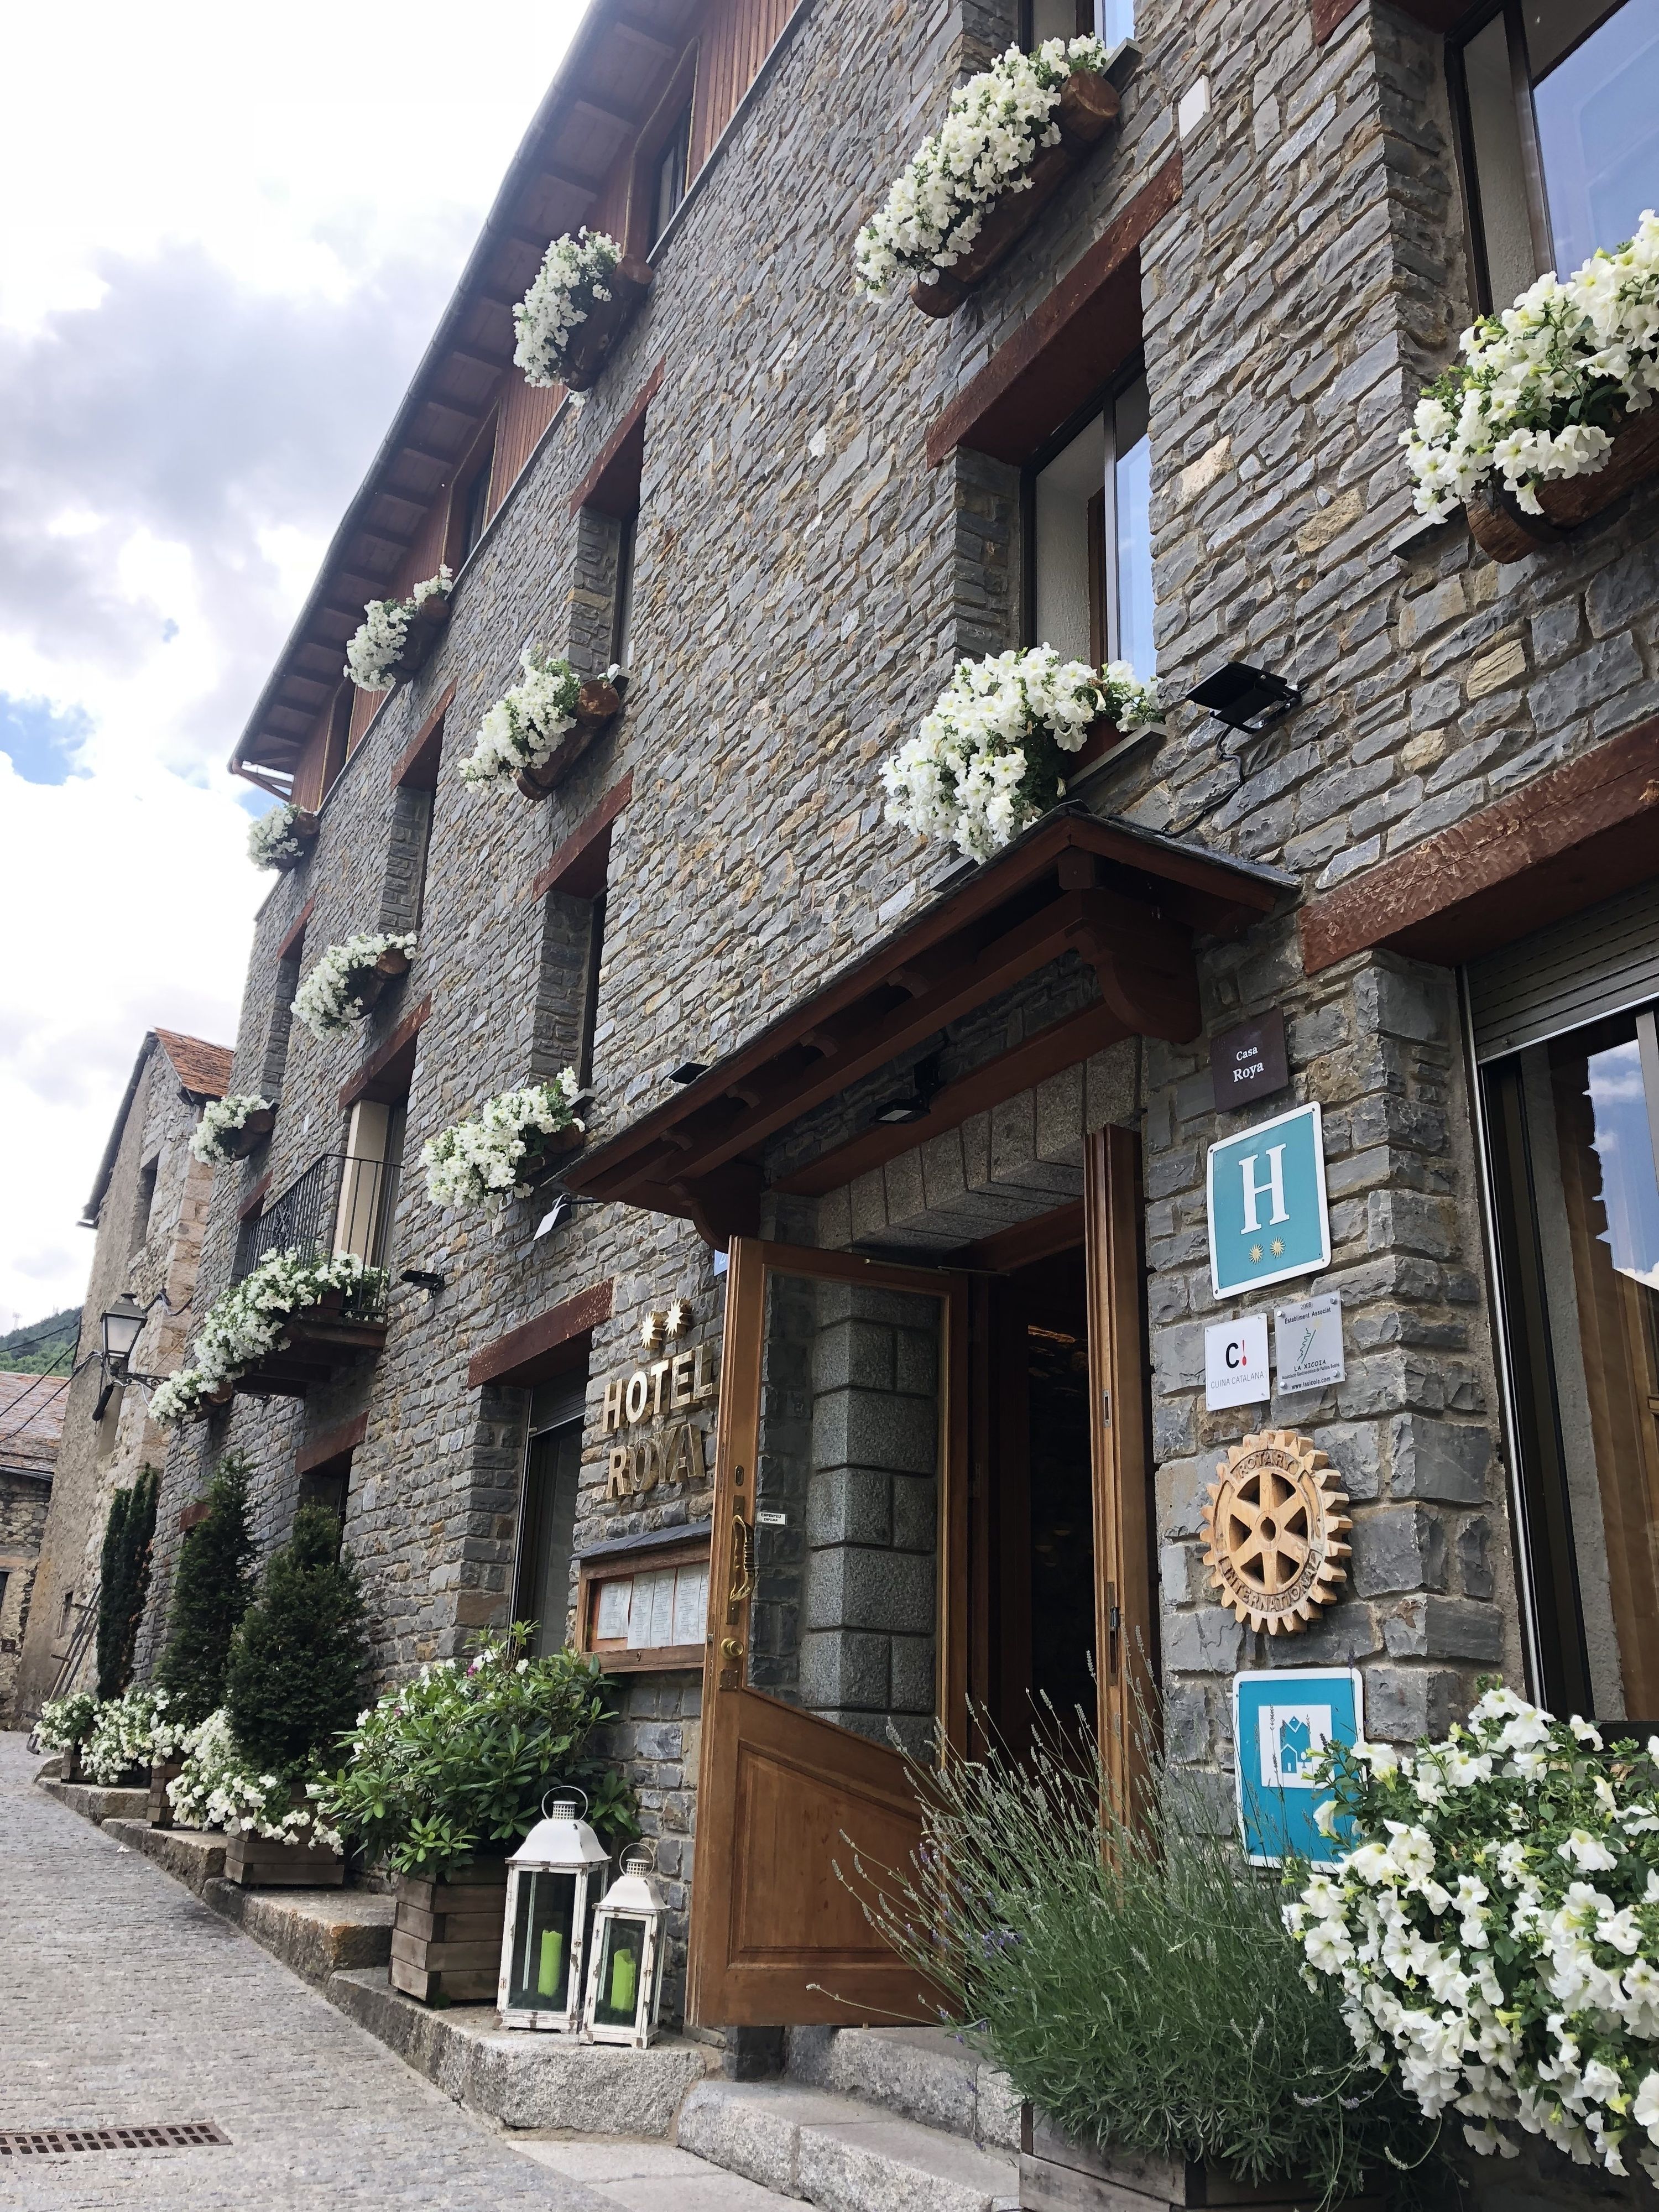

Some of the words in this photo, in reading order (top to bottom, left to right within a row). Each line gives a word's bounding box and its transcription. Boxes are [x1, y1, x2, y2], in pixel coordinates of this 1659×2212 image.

[1236, 1046, 1258, 1061] Casa
[1233, 1062, 1264, 1082] Roya
[1238, 1143, 1291, 1235] H
[1285, 1313, 1310, 1324] Establiment
[1312, 1307, 1331, 1317] Associat
[602, 1345, 716, 1433] HOTEL
[1211, 1378, 1230, 1389] CUINA
[1231, 1371, 1264, 1385] CATALANA
[608, 1423, 705, 1500] ROYA
[1234, 1450, 1298, 1481] ROTARY
[1220, 1550, 1322, 1613] INTERNATIONAL
